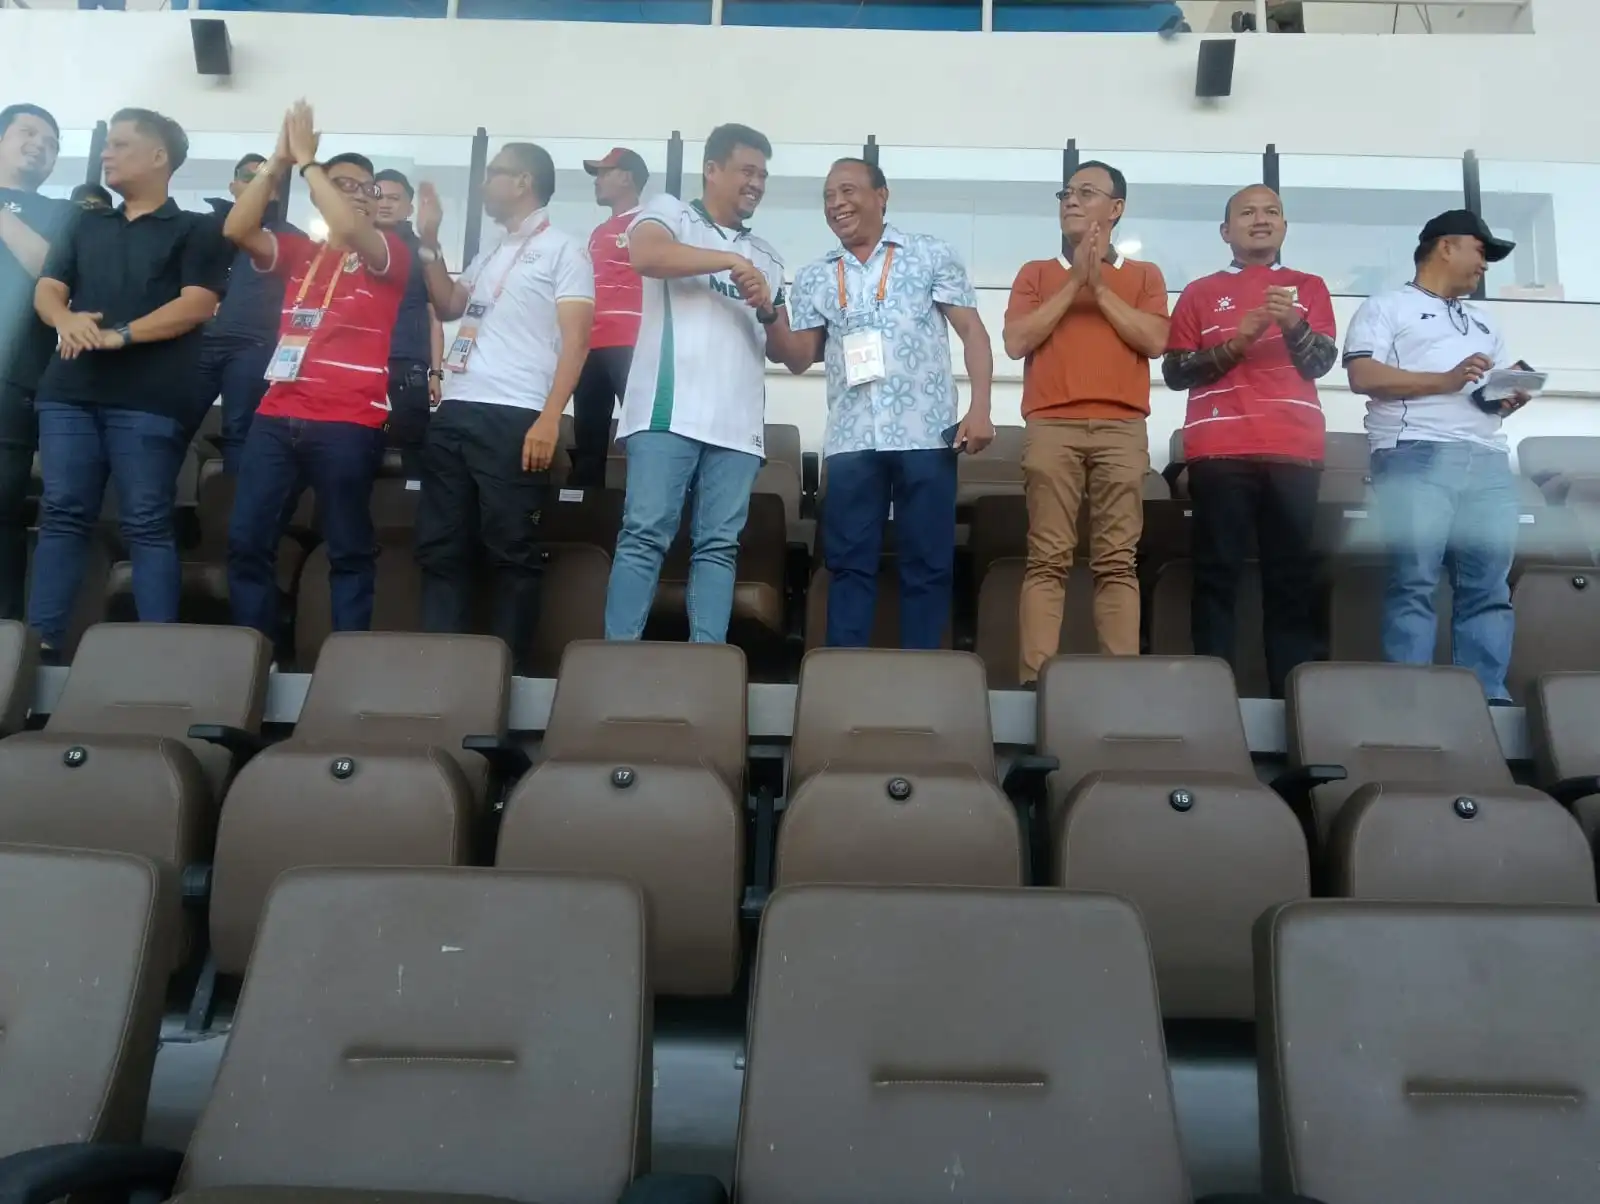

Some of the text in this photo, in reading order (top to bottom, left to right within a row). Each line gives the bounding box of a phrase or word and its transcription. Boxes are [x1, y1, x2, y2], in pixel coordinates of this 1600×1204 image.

[69, 751, 81, 759] 19
[336, 762, 350, 770] 18
[617, 771, 630, 779] 17
[1175, 794, 1188, 802] 15
[1460, 801, 1473, 809] 14
